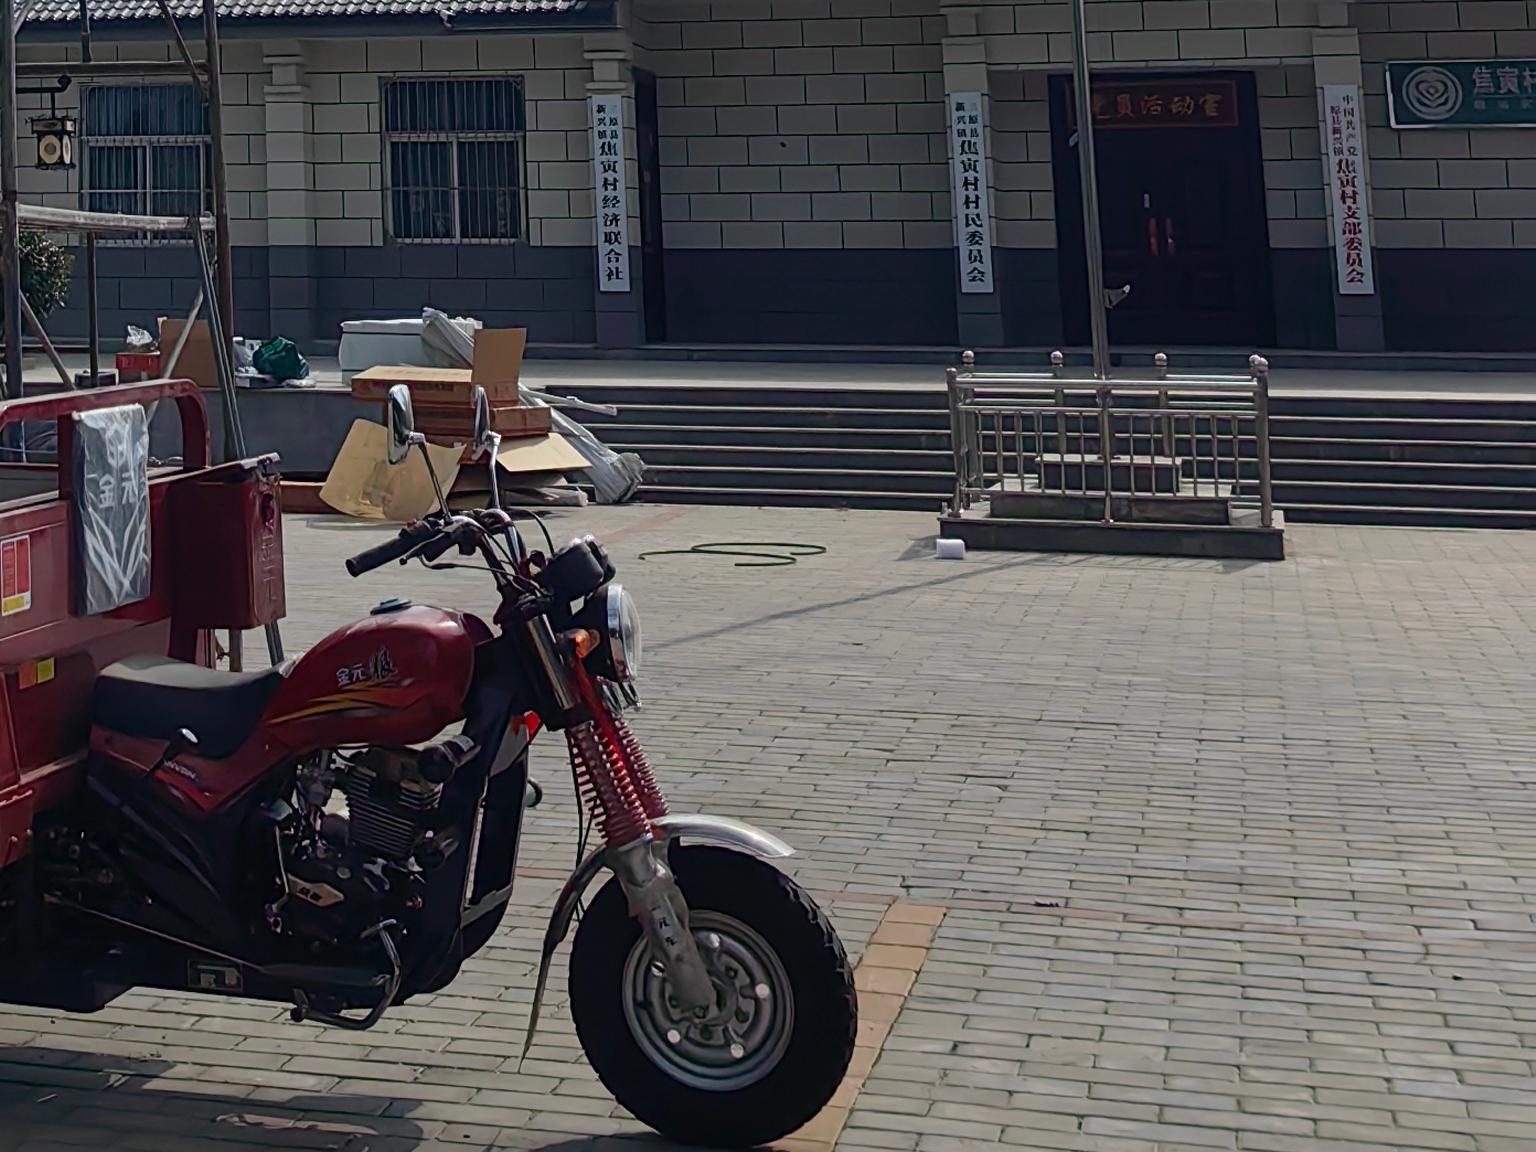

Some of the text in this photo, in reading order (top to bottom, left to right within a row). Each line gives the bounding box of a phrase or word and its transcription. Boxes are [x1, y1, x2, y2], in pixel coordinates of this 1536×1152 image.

[600, 142, 623, 281] 焦寅村经济联合社
[959, 139, 986, 283] 焦寅村村民委员会
